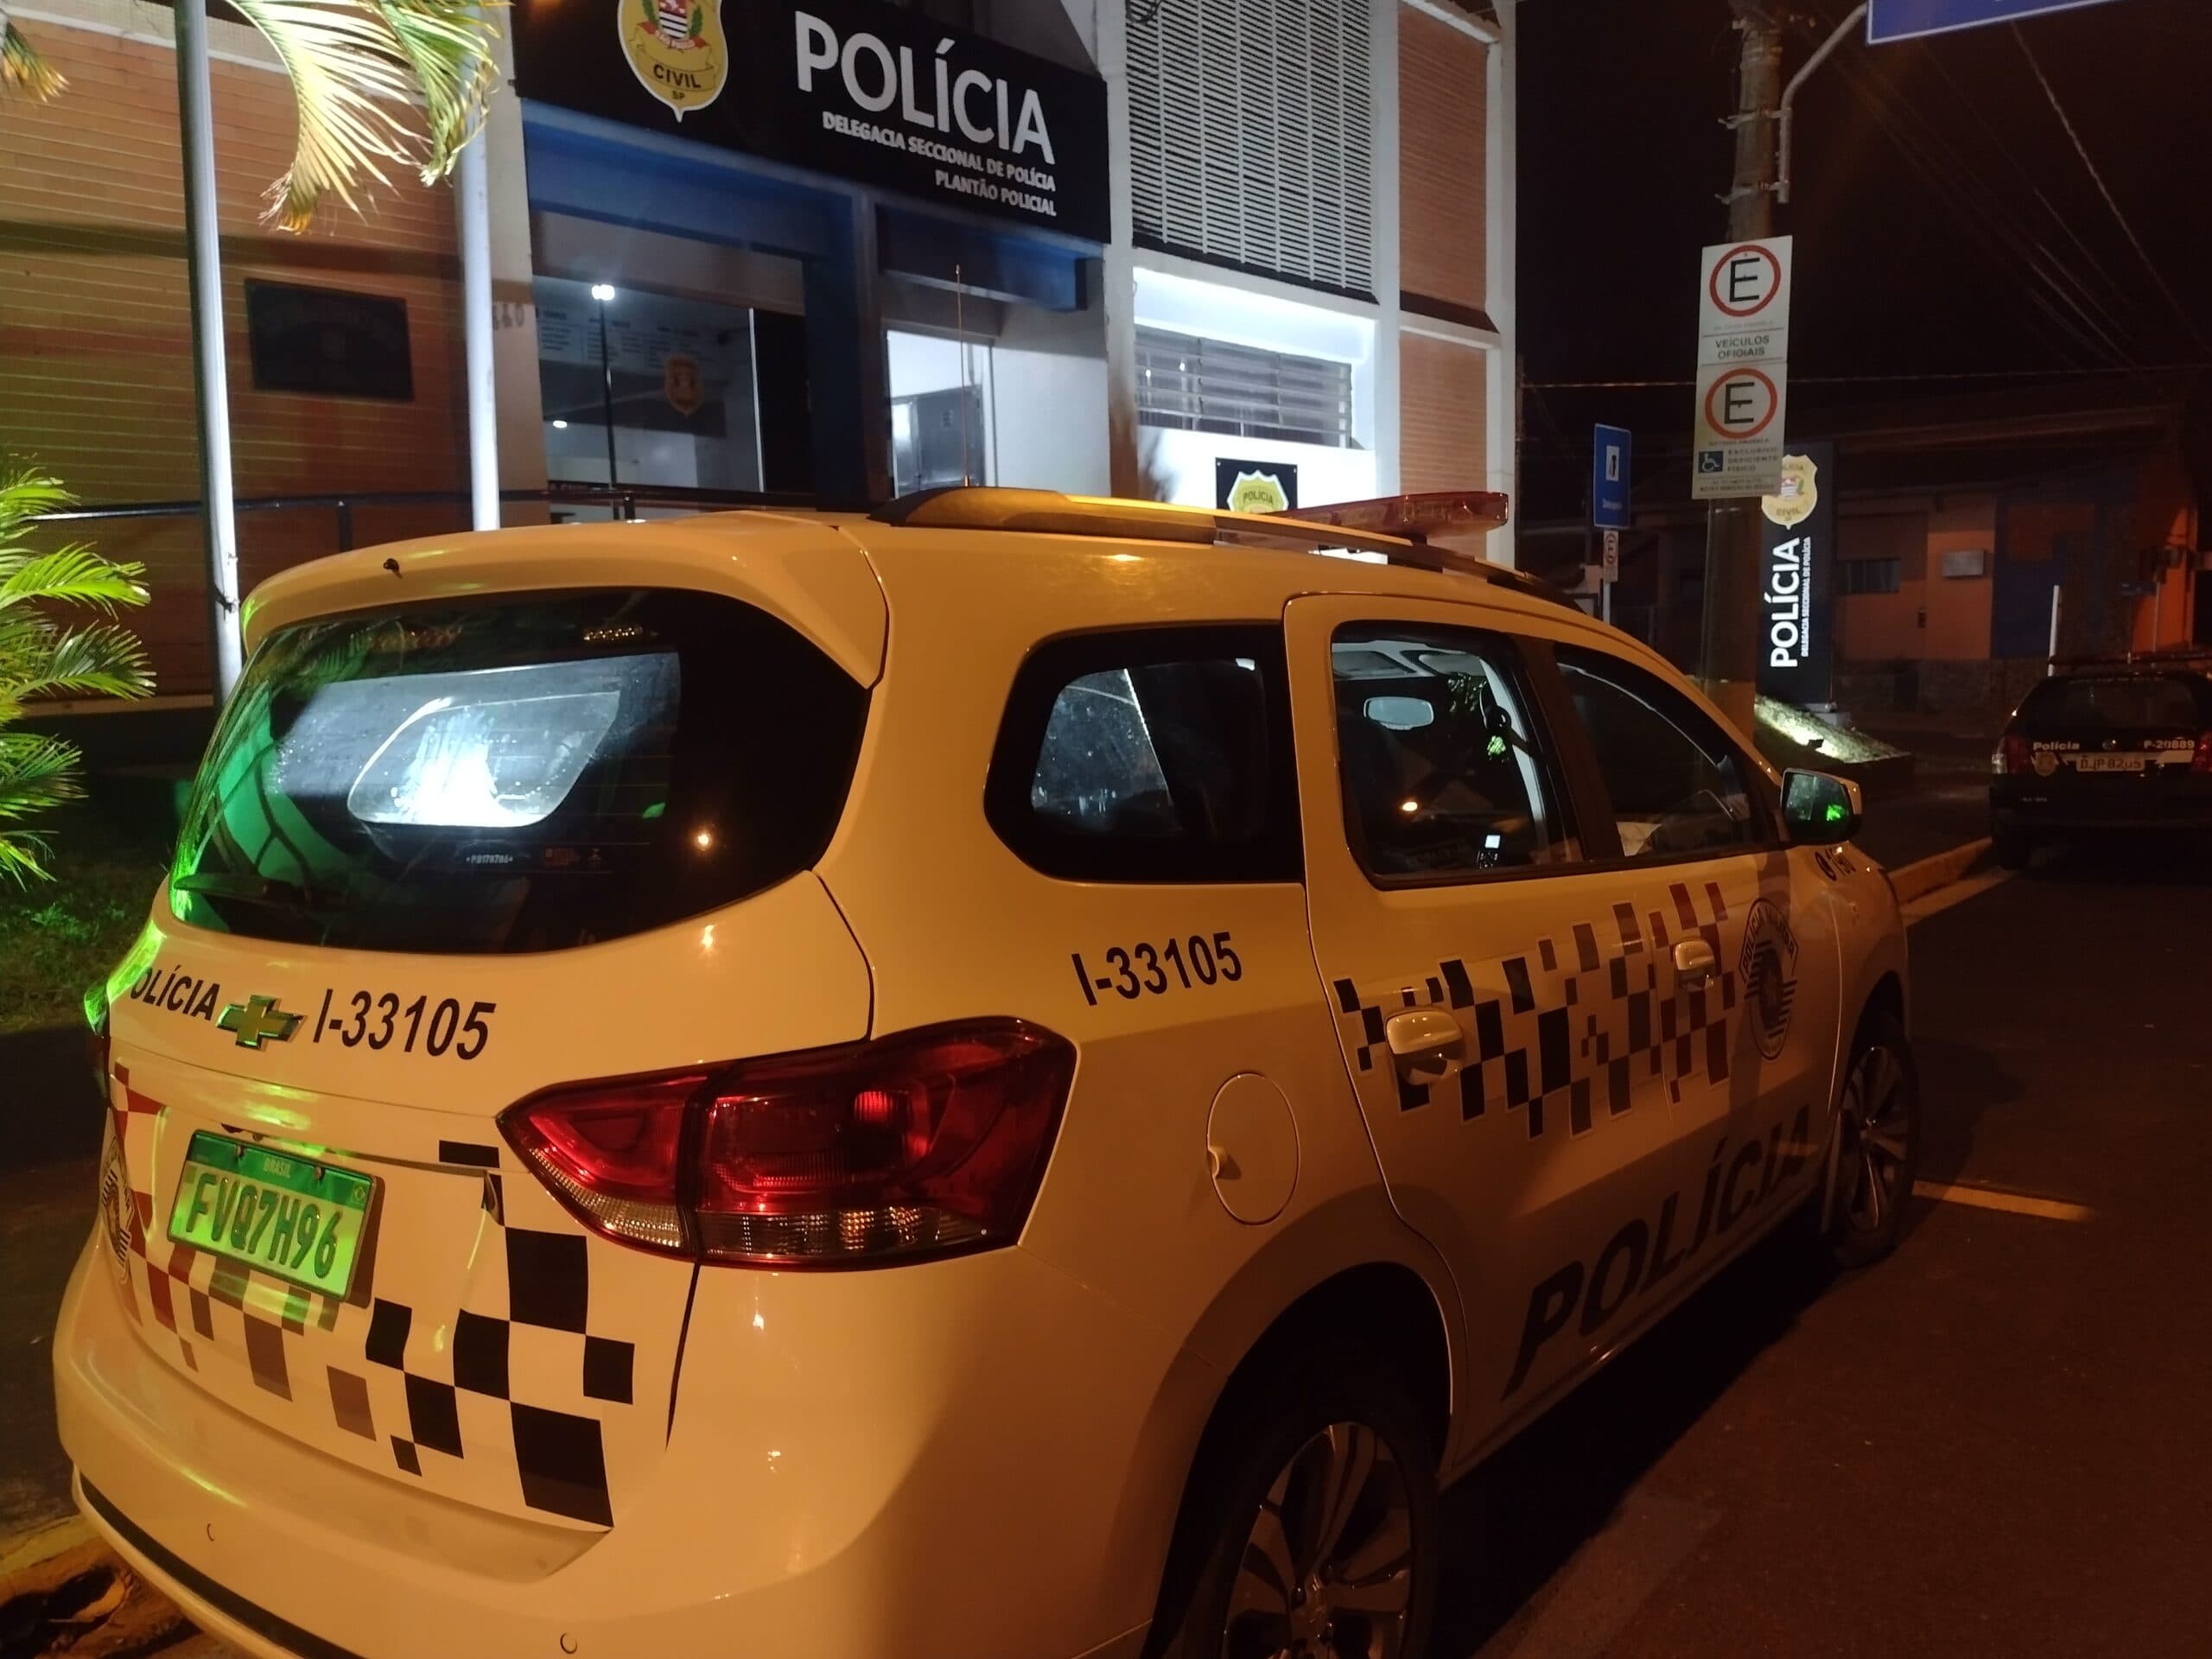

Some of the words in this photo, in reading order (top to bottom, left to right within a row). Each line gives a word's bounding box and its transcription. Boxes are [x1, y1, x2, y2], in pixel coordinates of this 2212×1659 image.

[653, 63, 702, 88] CIVIL
[795, 10, 1056, 165] POLÍCIA
[823, 111, 906, 149] DELEGACIA
[908, 136, 983, 172] SECCIONAL
[986, 158, 1004, 177] DE
[1007, 163, 1056, 192] POLÍCIA
[935, 169, 998, 200] PLANTÃO
[1001, 187, 1057, 216] POLICIAL
[1729, 257, 1760, 302] E
[1725, 382, 1755, 423] E
[1764, 537, 1802, 667] POLÍCIA
[2033, 741, 2080, 750] Polícia
[130, 964, 220, 1021] OLÍCIA
[1071, 931, 1243, 1005] I-33105
[313, 988, 496, 1060] I-33105
[186, 1173, 343, 1280] FVQ7H96
[1501, 1104, 1817, 1401] POLÍCIA
